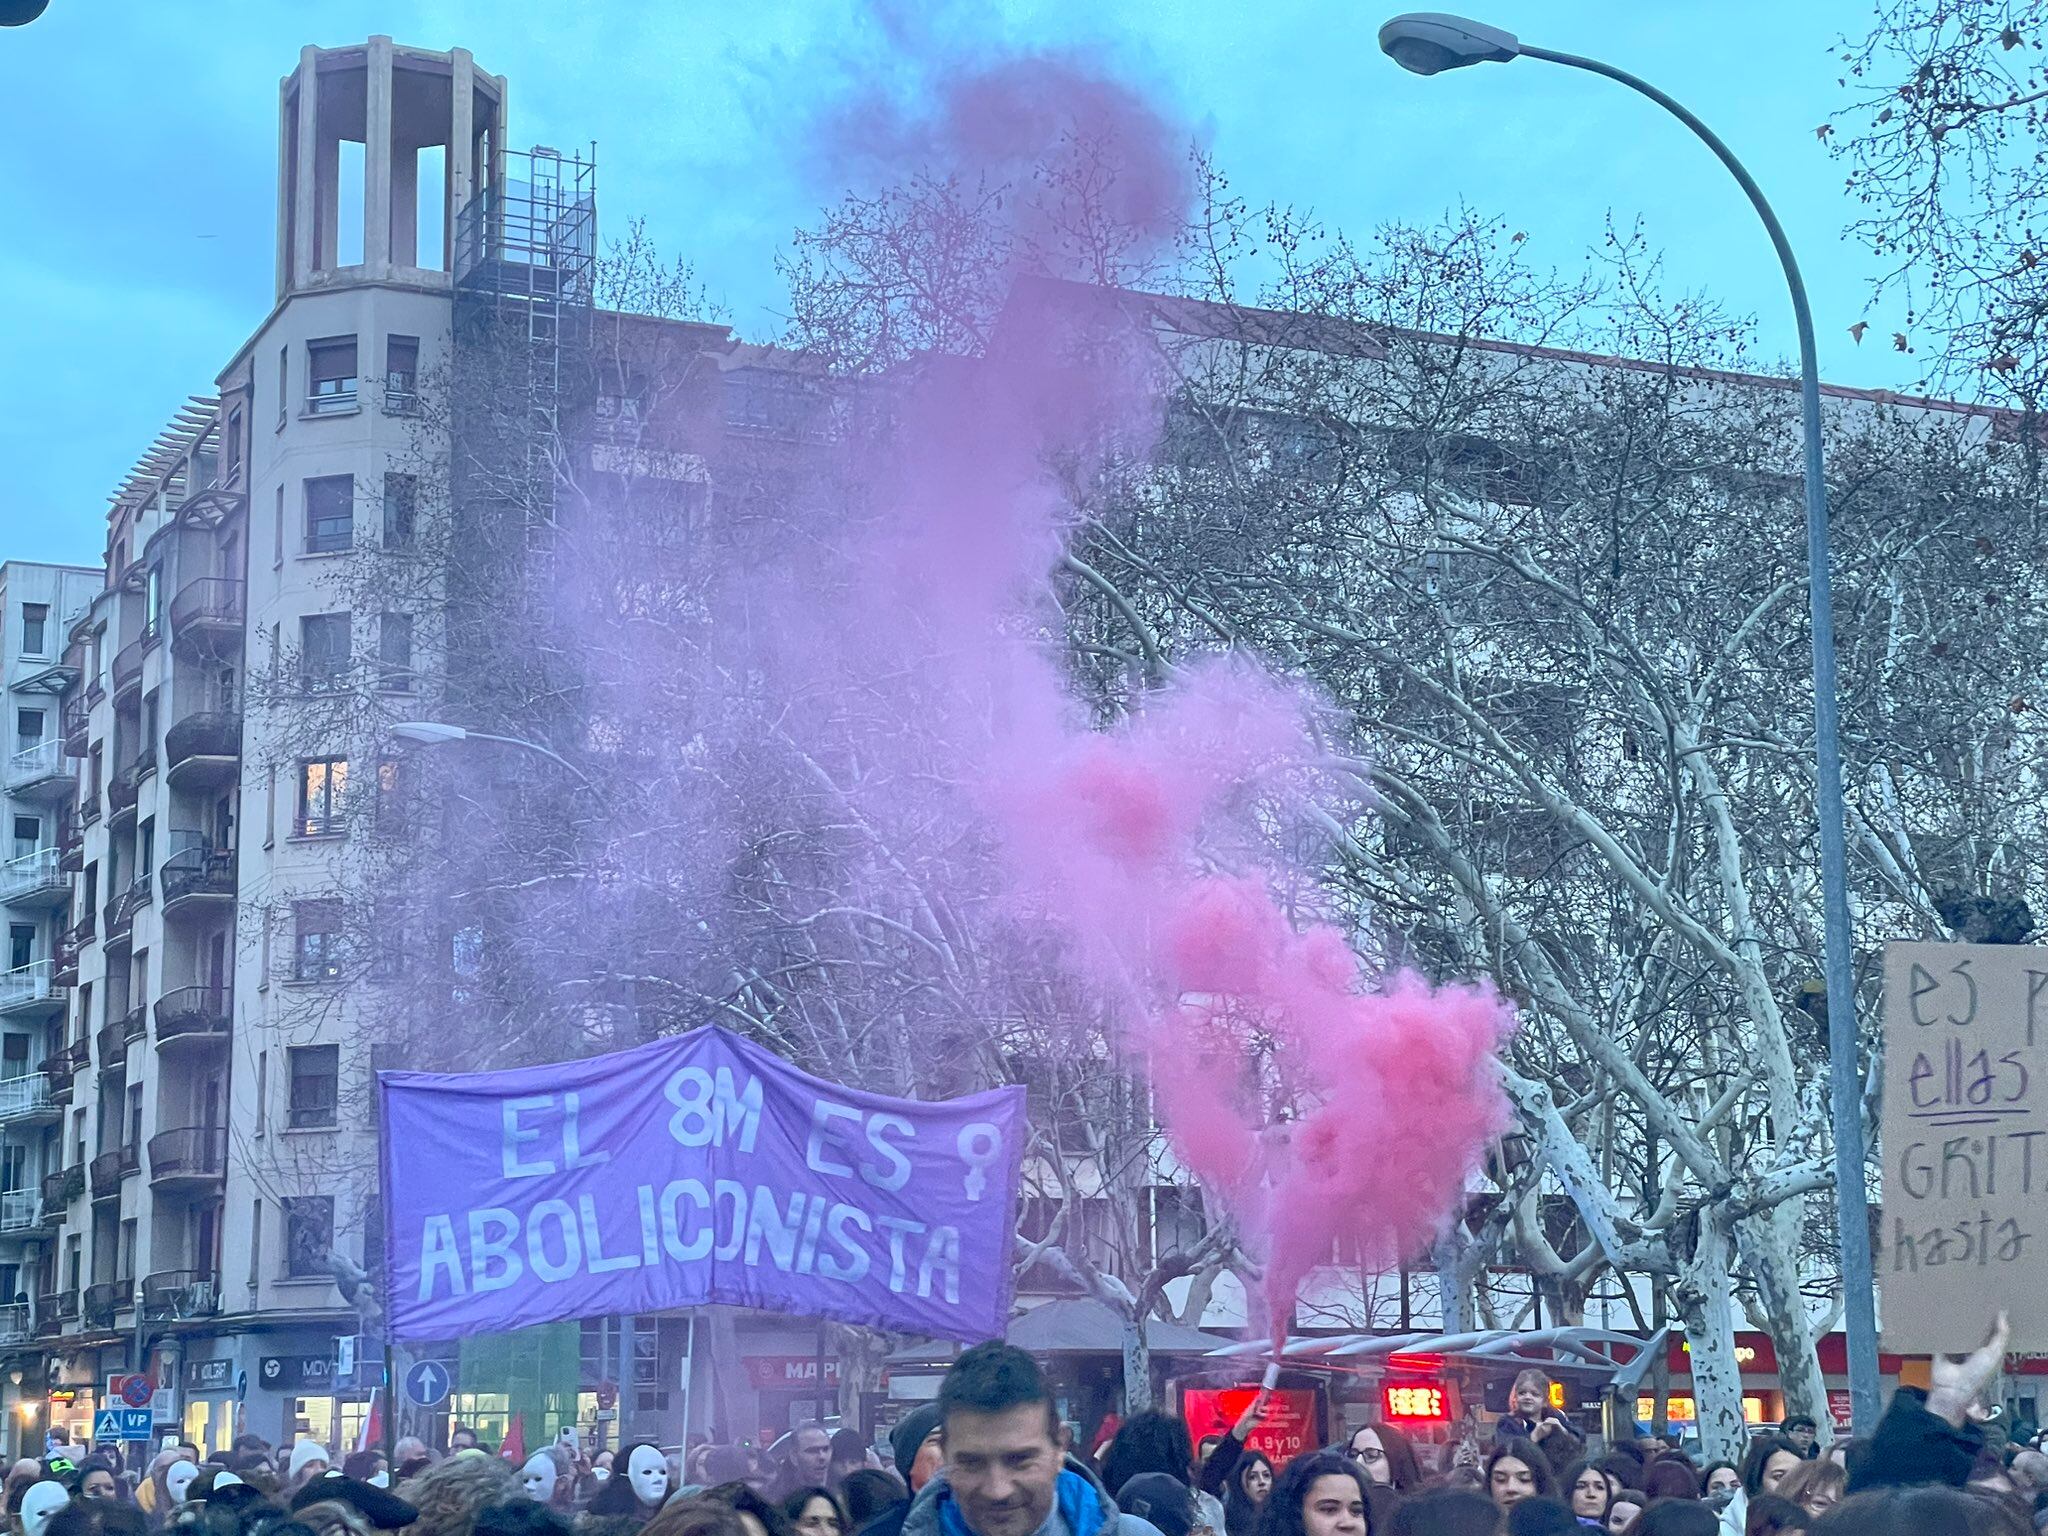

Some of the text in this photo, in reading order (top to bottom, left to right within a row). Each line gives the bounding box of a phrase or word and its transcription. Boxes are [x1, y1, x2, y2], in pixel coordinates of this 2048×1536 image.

[1908, 960, 1978, 1026] es
[1909, 1037, 2028, 1107] ellas
[502, 1066, 915, 1191] EL 8M ES
[1901, 1131, 2048, 1199] GRIT
[1894, 1210, 2031, 1272] hasta
[127, 1414, 147, 1426] VP
[1276, 1439, 1284, 1455] y
[1285, 1437, 1300, 1448] 10
